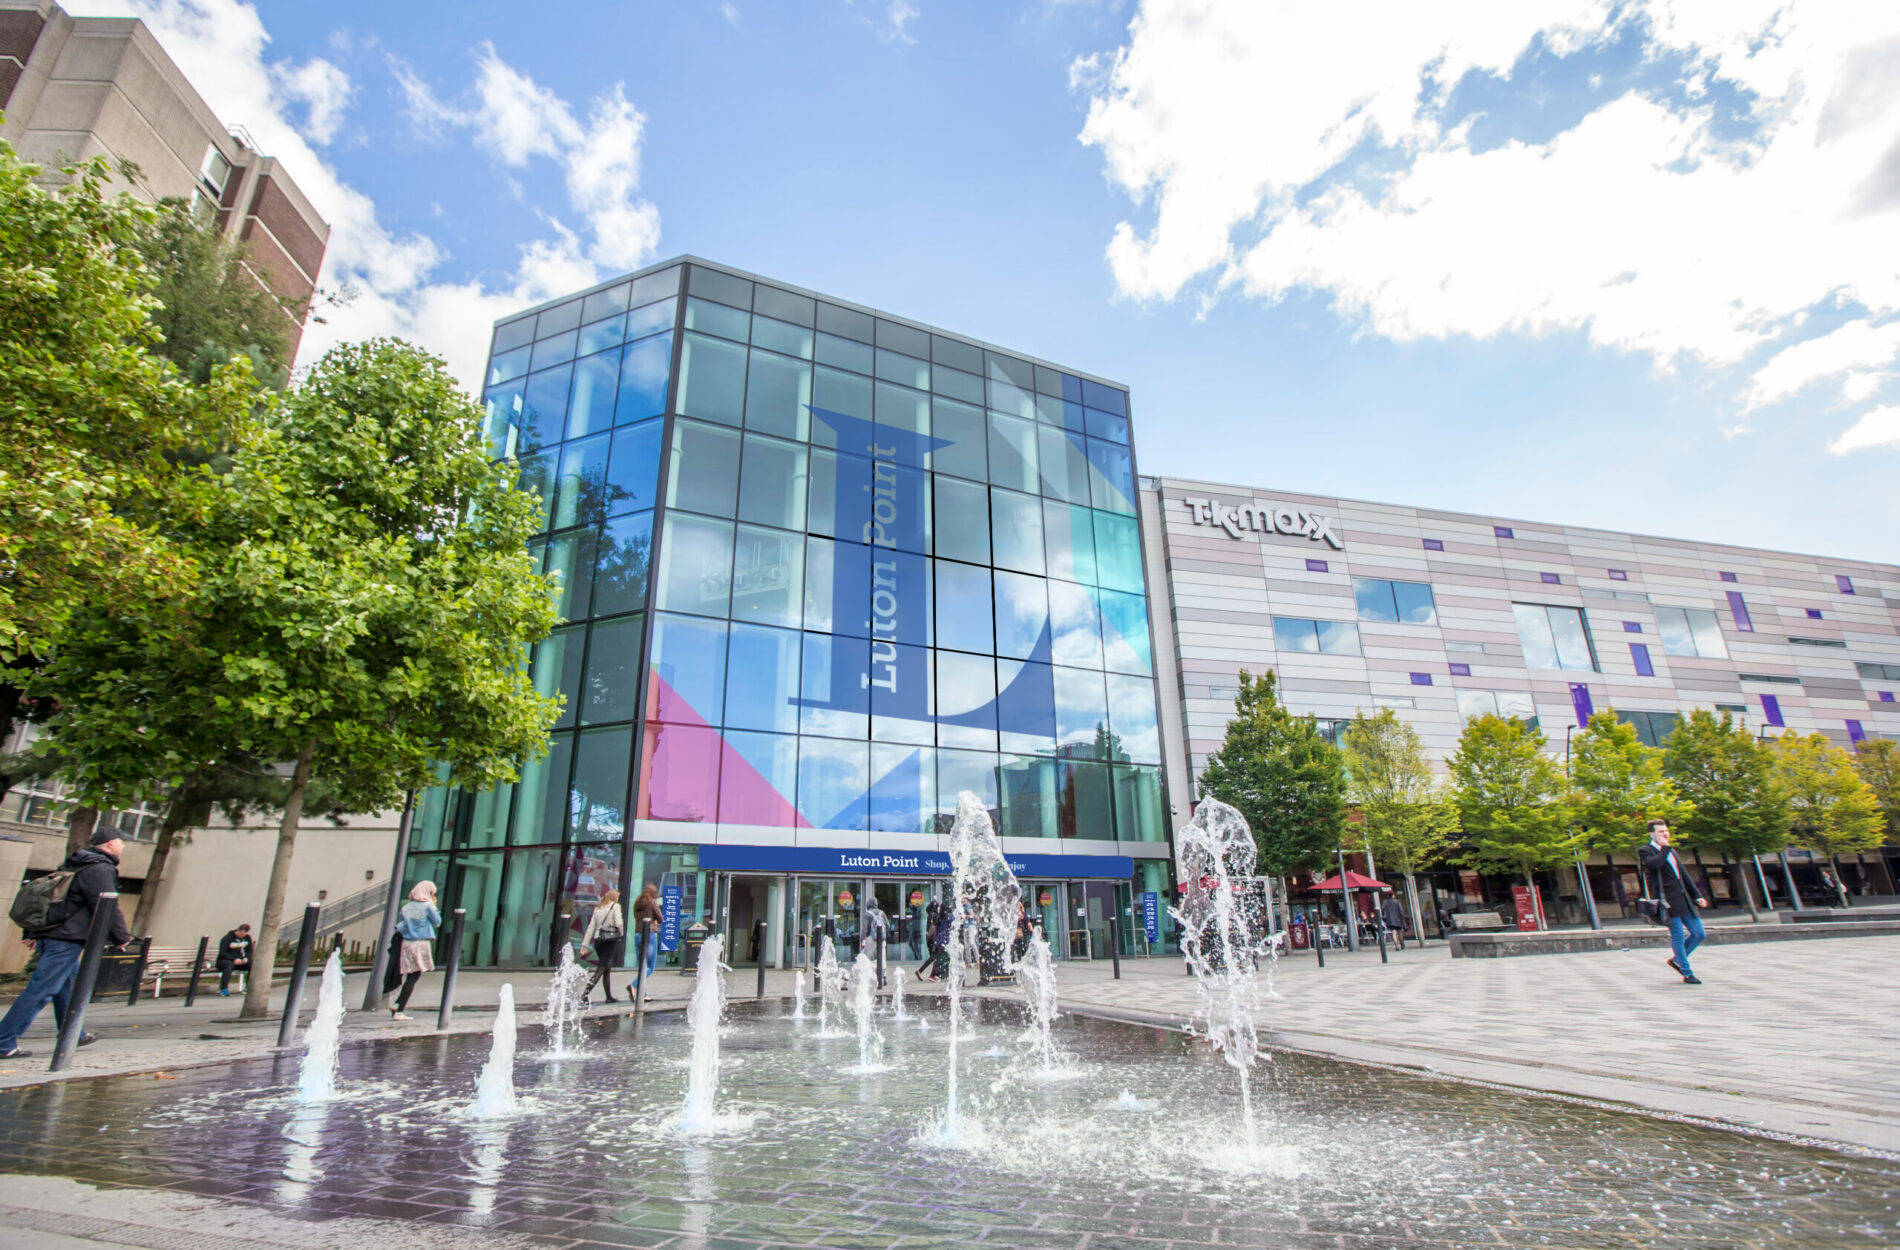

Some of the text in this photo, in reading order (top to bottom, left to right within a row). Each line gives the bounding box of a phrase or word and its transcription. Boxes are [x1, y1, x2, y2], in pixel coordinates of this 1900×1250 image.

[861, 442, 897, 693] Luton Point
[840, 855, 880, 867] Luton
[883, 856, 919, 868] Point
[1008, 861, 1027, 872] njoy
